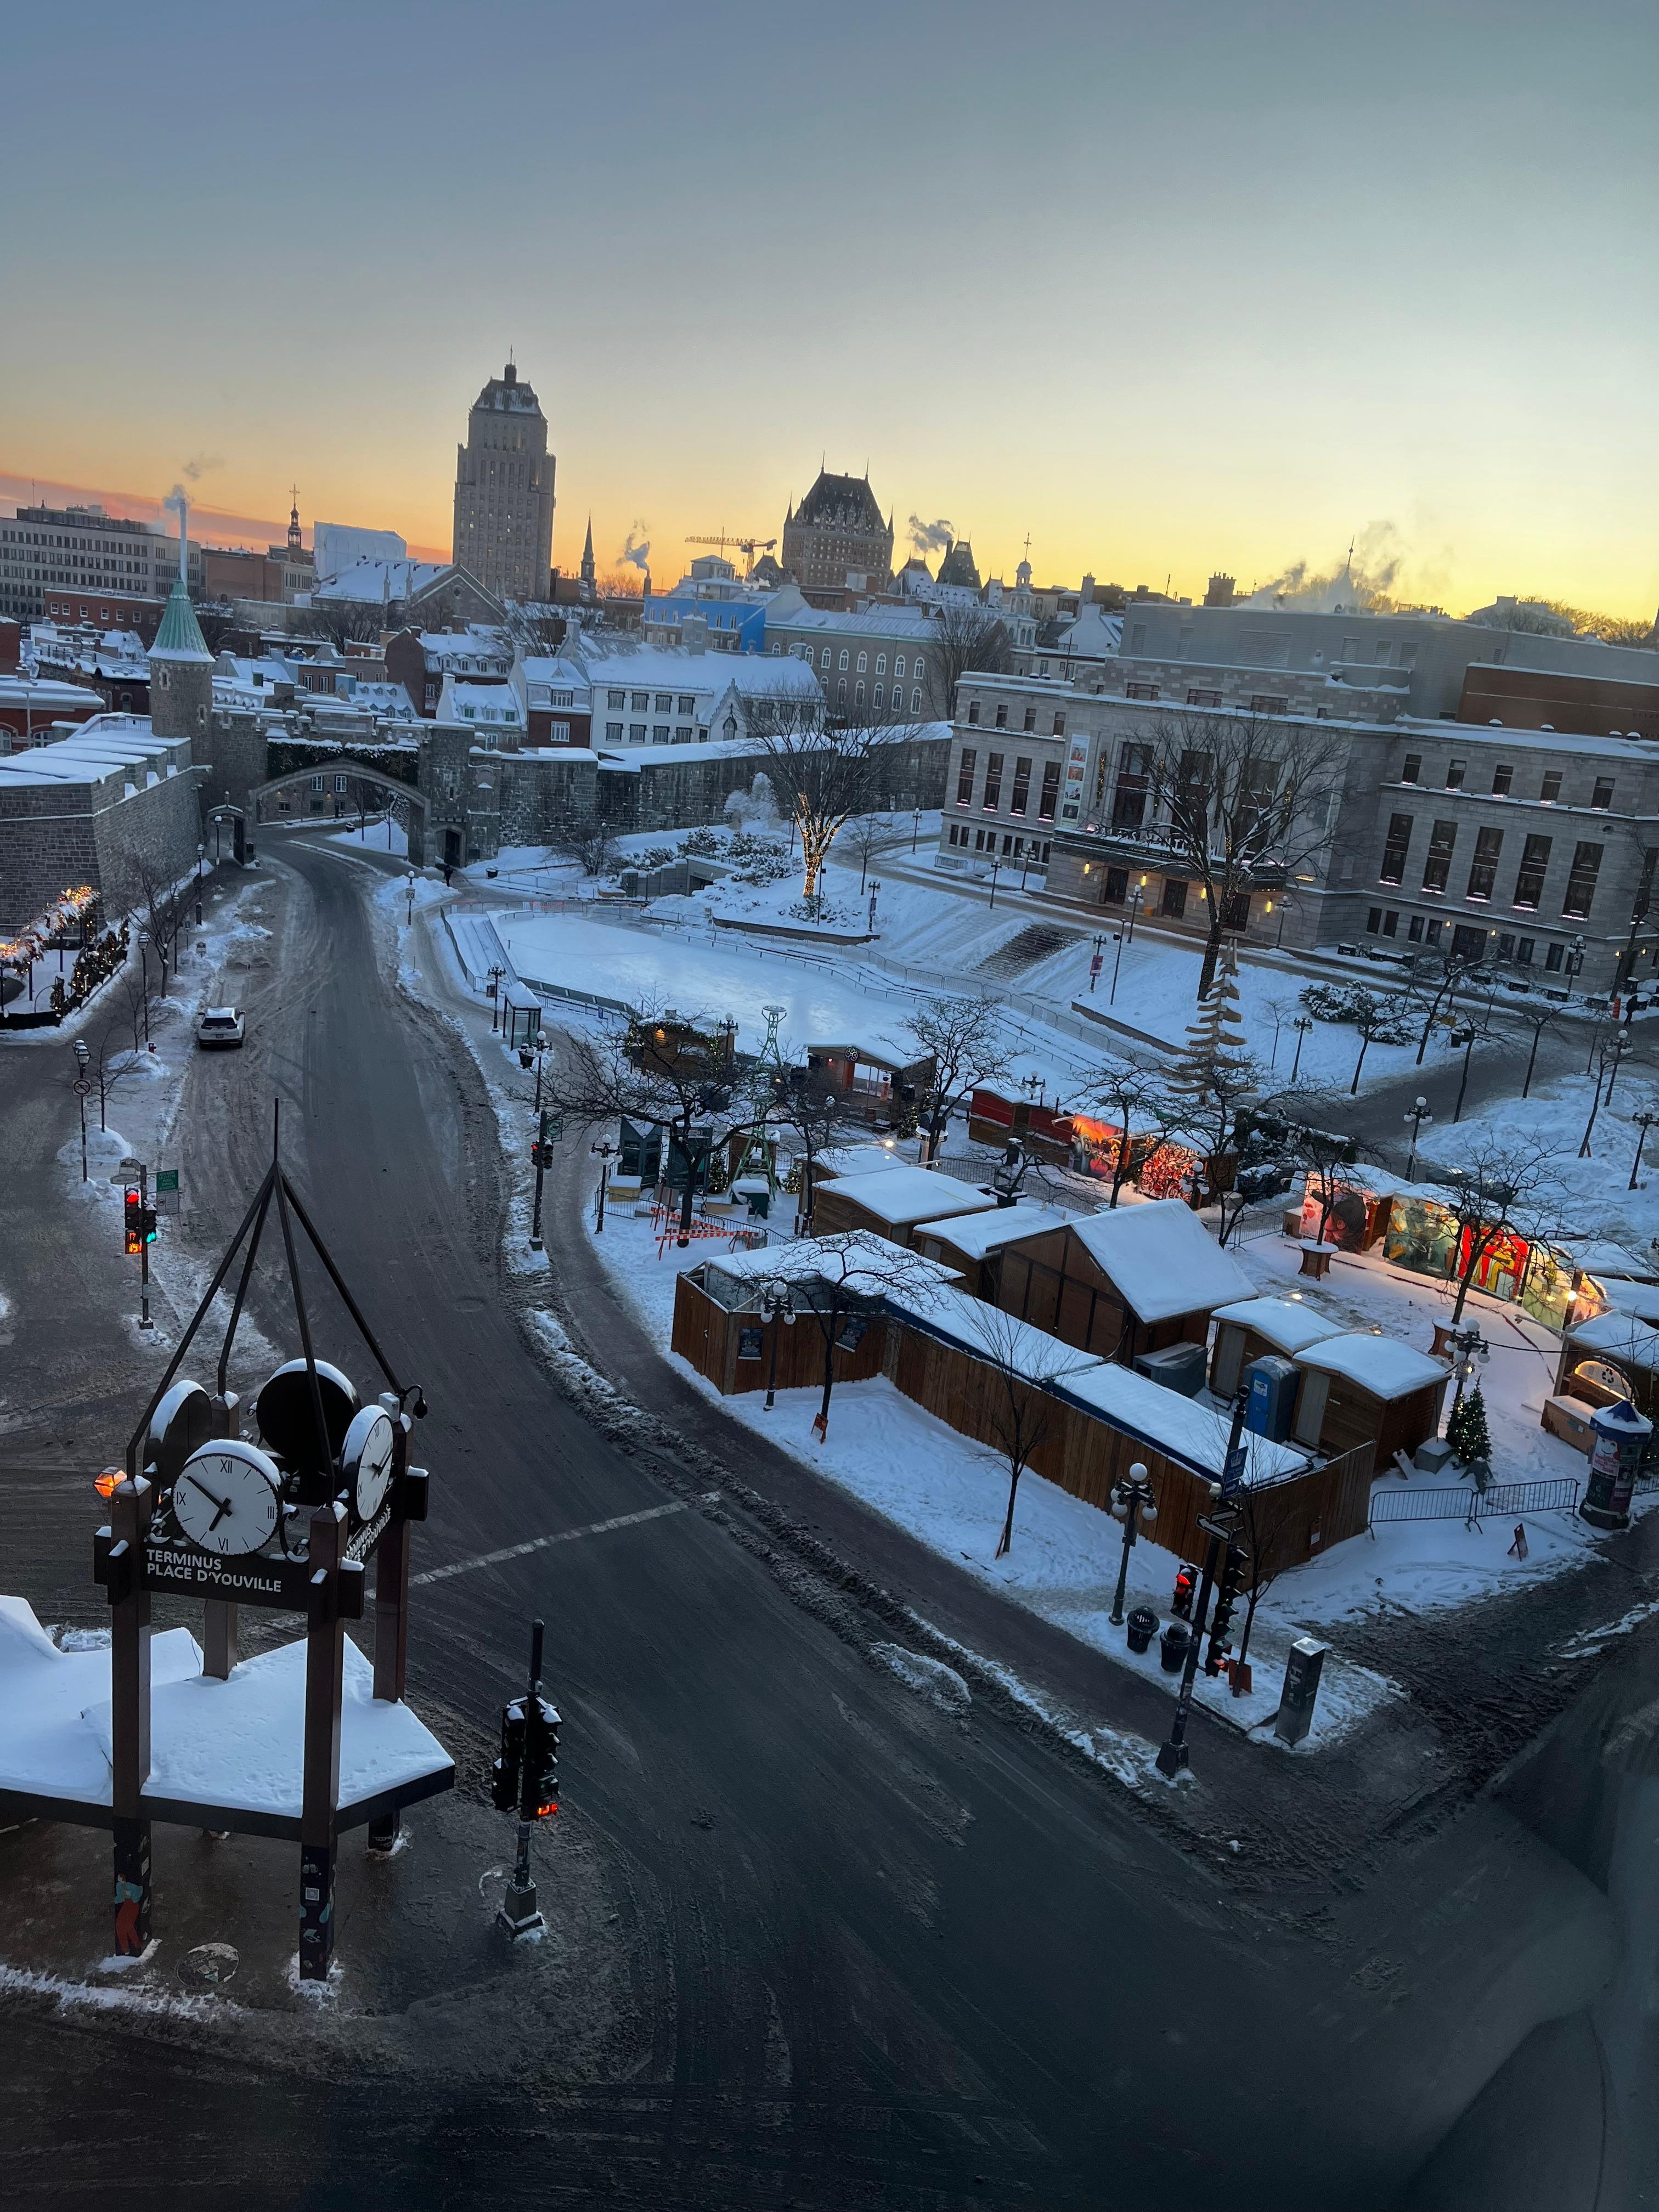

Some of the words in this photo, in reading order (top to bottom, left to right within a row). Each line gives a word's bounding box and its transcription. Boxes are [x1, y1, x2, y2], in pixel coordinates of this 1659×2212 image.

[220, 1459, 233, 1474] XII
[176, 1491, 187, 1506] IX
[218, 1537, 228, 1551] VI
[146, 1549, 222, 1570] TERMINUS
[147, 1562, 192, 1580] PLACE
[197, 1570, 281, 1593] D'YOUVILLE
